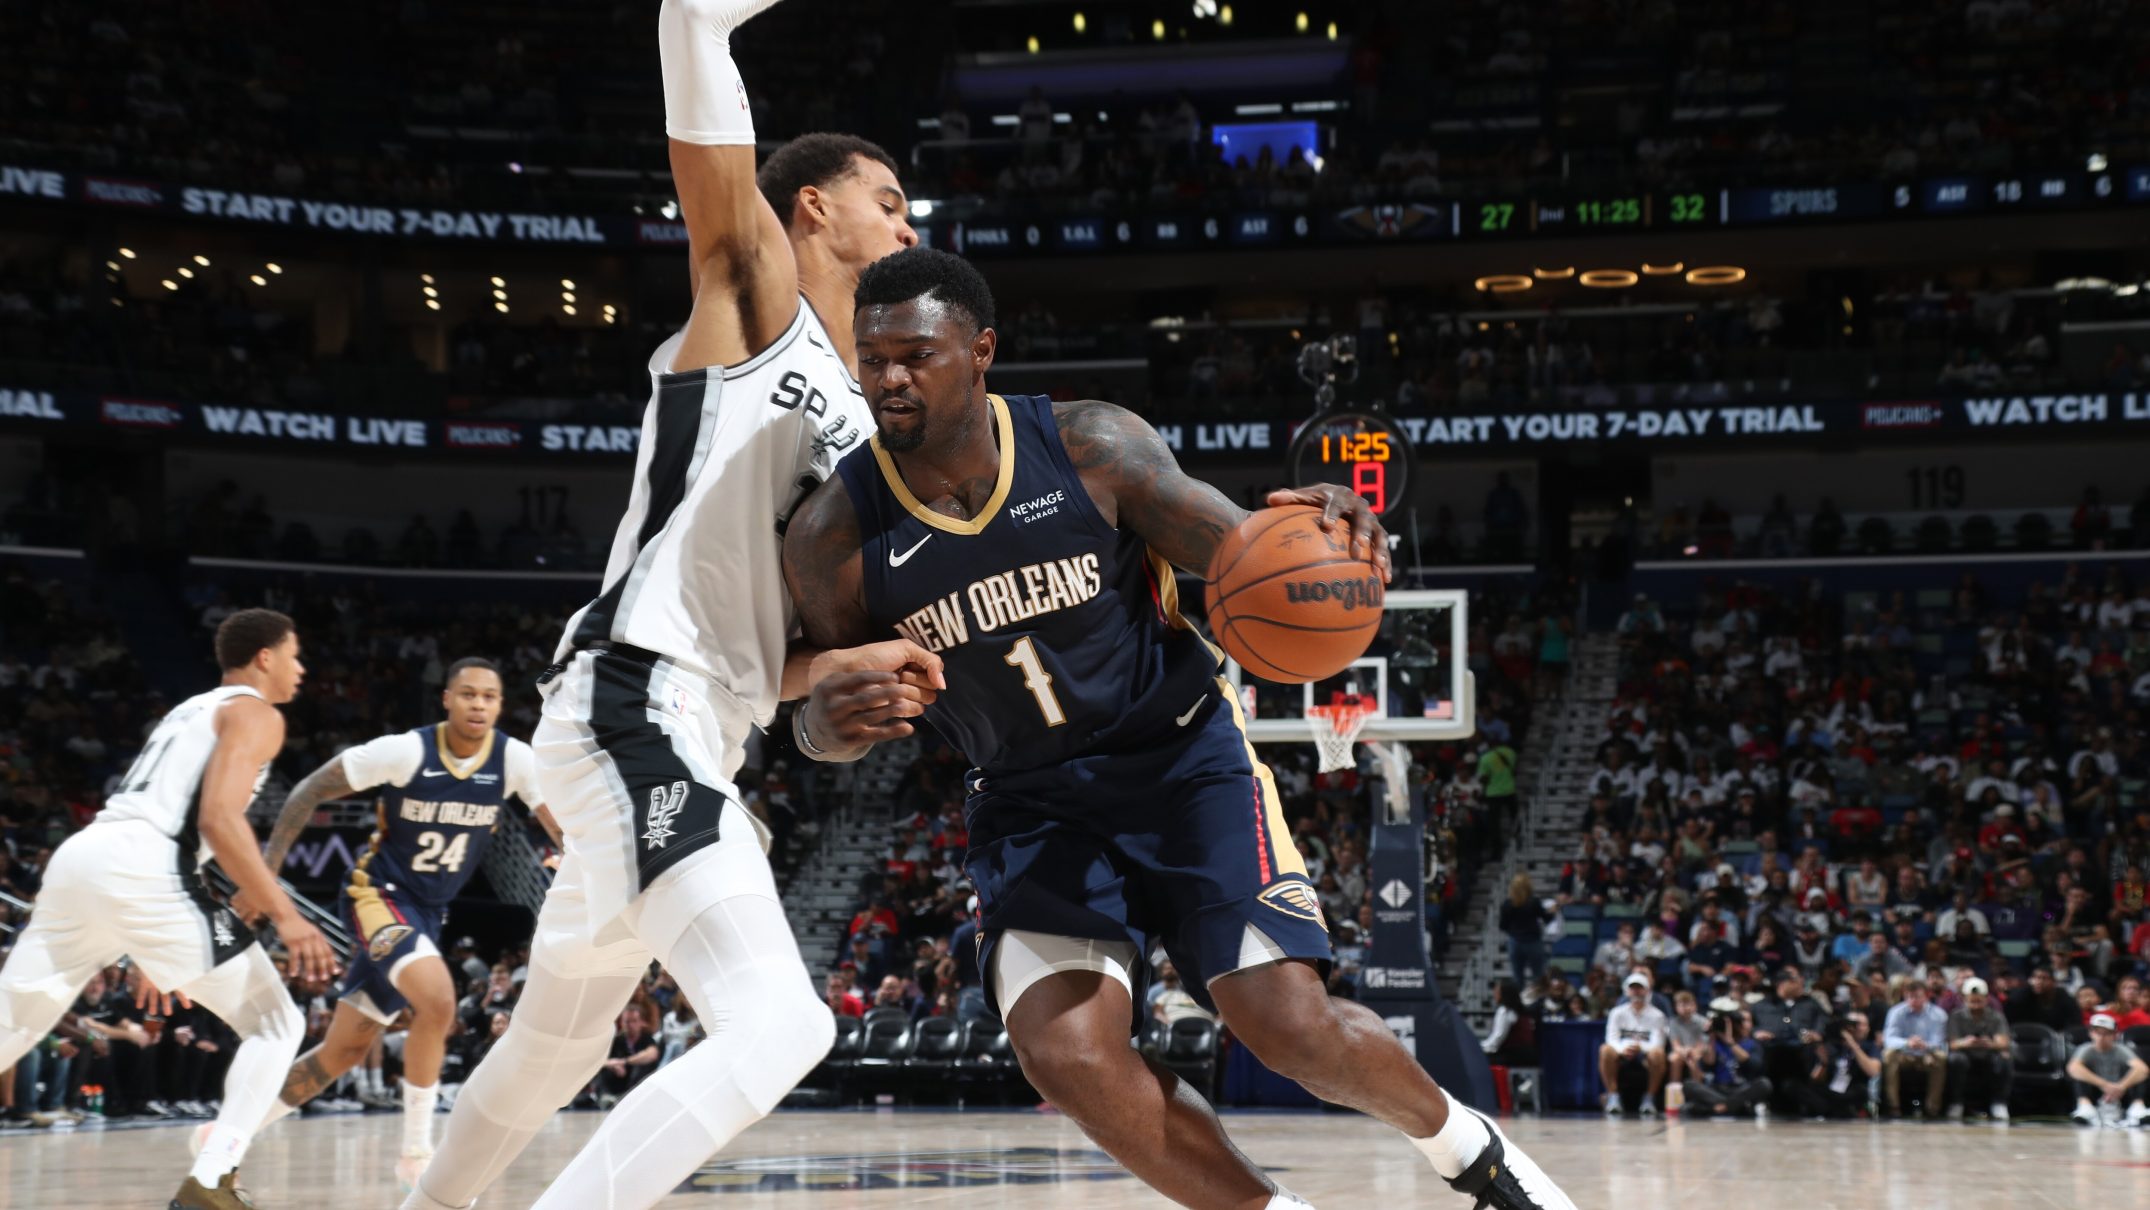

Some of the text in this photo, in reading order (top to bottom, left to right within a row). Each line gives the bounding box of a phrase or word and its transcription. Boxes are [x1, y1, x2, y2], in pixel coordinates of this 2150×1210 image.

[181, 187, 297, 223] START
[301, 202, 396, 234] YOUR
[402, 209, 502, 240] 7-DAY
[508, 212, 605, 243] TRIAL
[1480, 203, 1514, 231] 27
[1576, 199, 1641, 225] 11:25
[1669, 193, 1706, 222] 32
[0, 387, 66, 420] IAL
[1964, 393, 2109, 426] WATCH
[201, 404, 427, 447] WATCH LIVE
[1196, 422, 1270, 450] LIVE
[1502, 411, 1600, 441] YOUR
[1604, 407, 1713, 438] 7-DAY
[1719, 404, 1825, 434] TRIAL
[1321, 431, 1391, 463] 11:25
[1009, 489, 1065, 519] NEWAGE
[1906, 465, 1965, 508] 119
[1023, 506, 1060, 524] GARAGE
[966, 552, 1102, 634] ORLEANS
[1003, 635, 1069, 728] 1
[400, 797, 500, 827] NEW ORLEANS
[411, 831, 471, 873] 24
